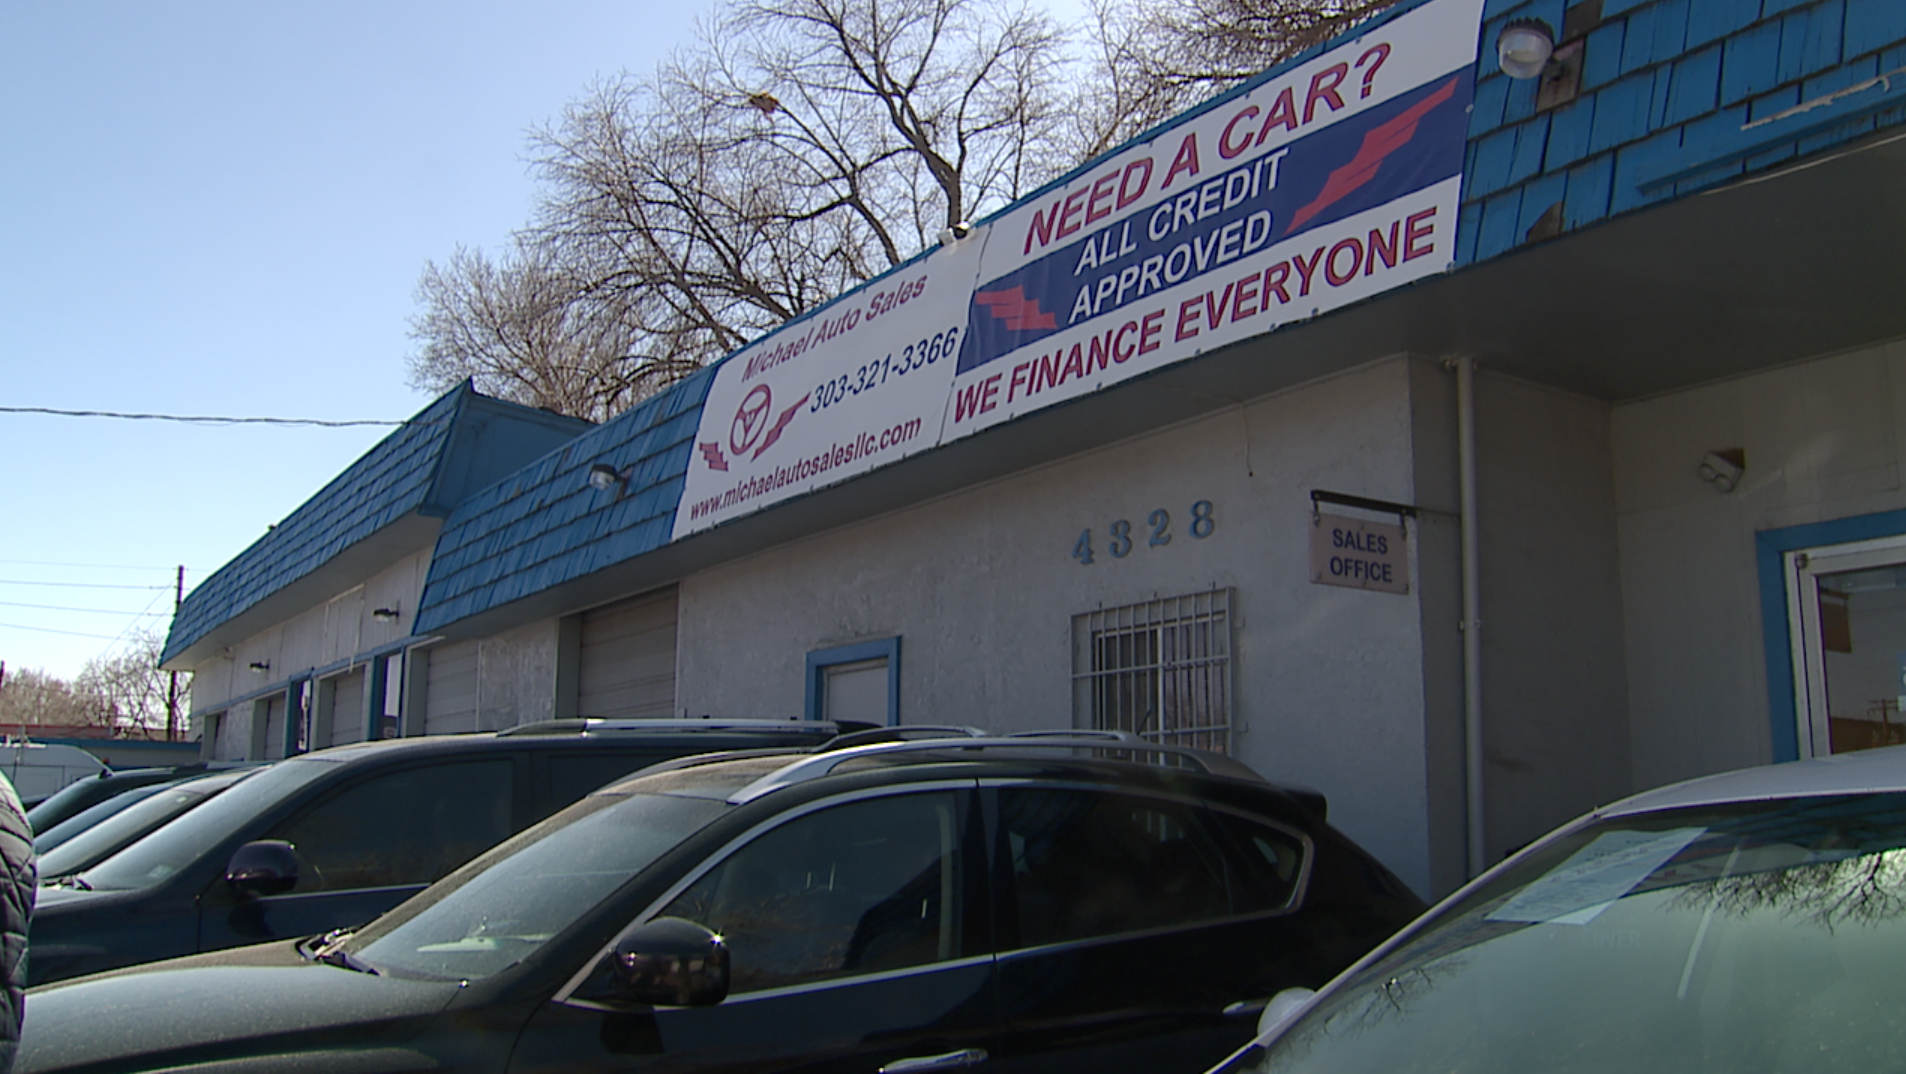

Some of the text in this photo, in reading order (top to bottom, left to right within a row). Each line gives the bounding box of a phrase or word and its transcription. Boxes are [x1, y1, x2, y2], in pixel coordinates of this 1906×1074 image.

[1023, 42, 1391, 255] NEED A CAR?
[1073, 148, 1288, 276] ALL CREDIT
[954, 206, 1437, 424] WE FINANCE EVERYONE
[1068, 209, 1273, 324] APPROVED
[741, 275, 928, 383] Michael Auto Sales
[810, 326, 959, 413] 303-321-3366
[690, 416, 922, 520] www.michaelautosalesllc.com
[1329, 556, 1393, 583] OFFICE
[1332, 528, 1388, 555] SALES
